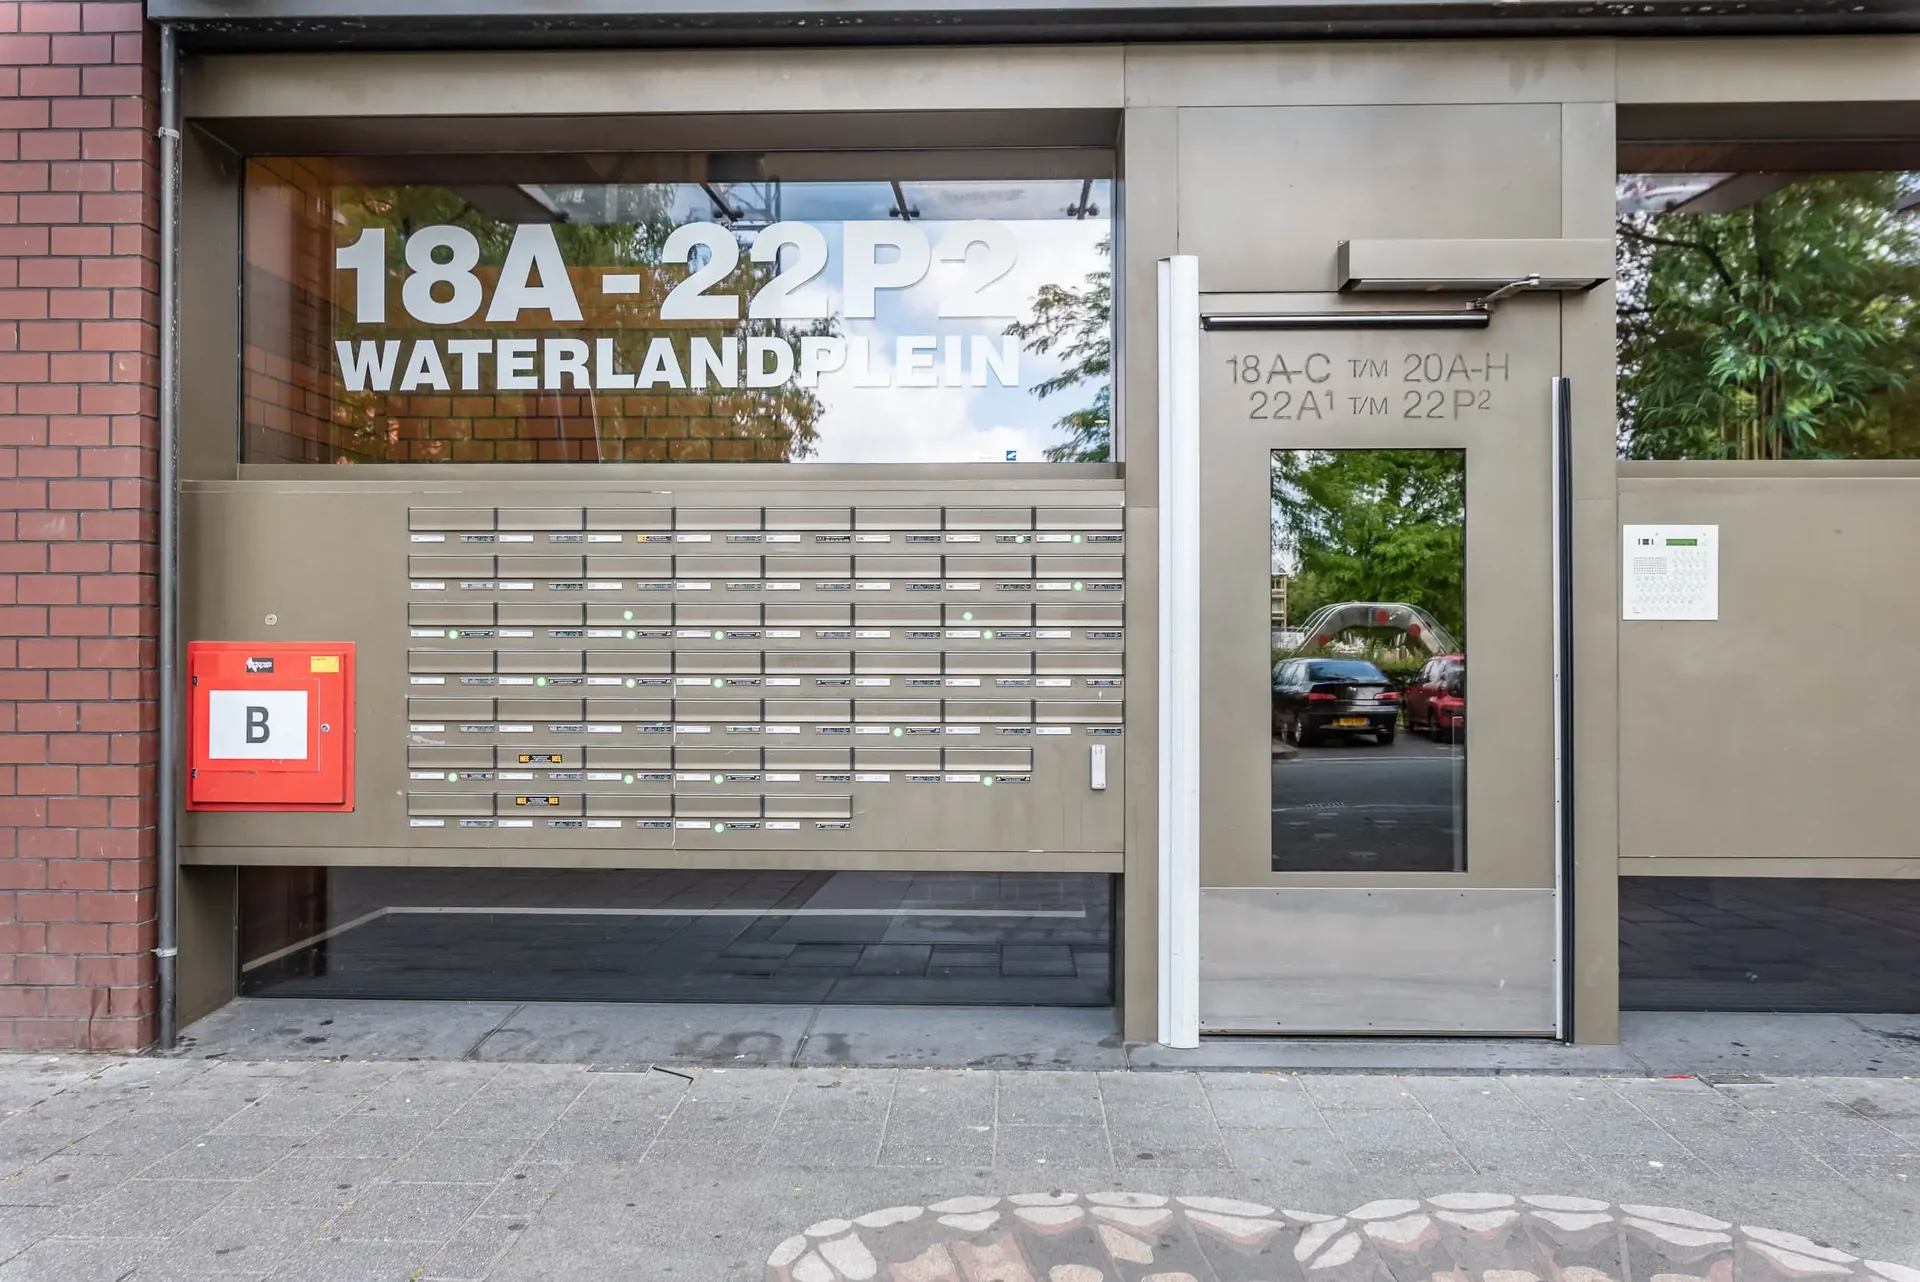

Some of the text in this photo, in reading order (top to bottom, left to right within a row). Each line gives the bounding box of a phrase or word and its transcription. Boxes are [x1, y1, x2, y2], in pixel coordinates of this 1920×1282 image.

[335, 223, 584, 325] 18A
[660, 220, 1018, 320] 22P2
[335, 336, 1020, 391] WATERLANDPLEIN
[1225, 352, 1510, 385] 18A-C T/M 20A-H
[1347, 396, 1389, 416] T/M
[245, 705, 271, 744] B
